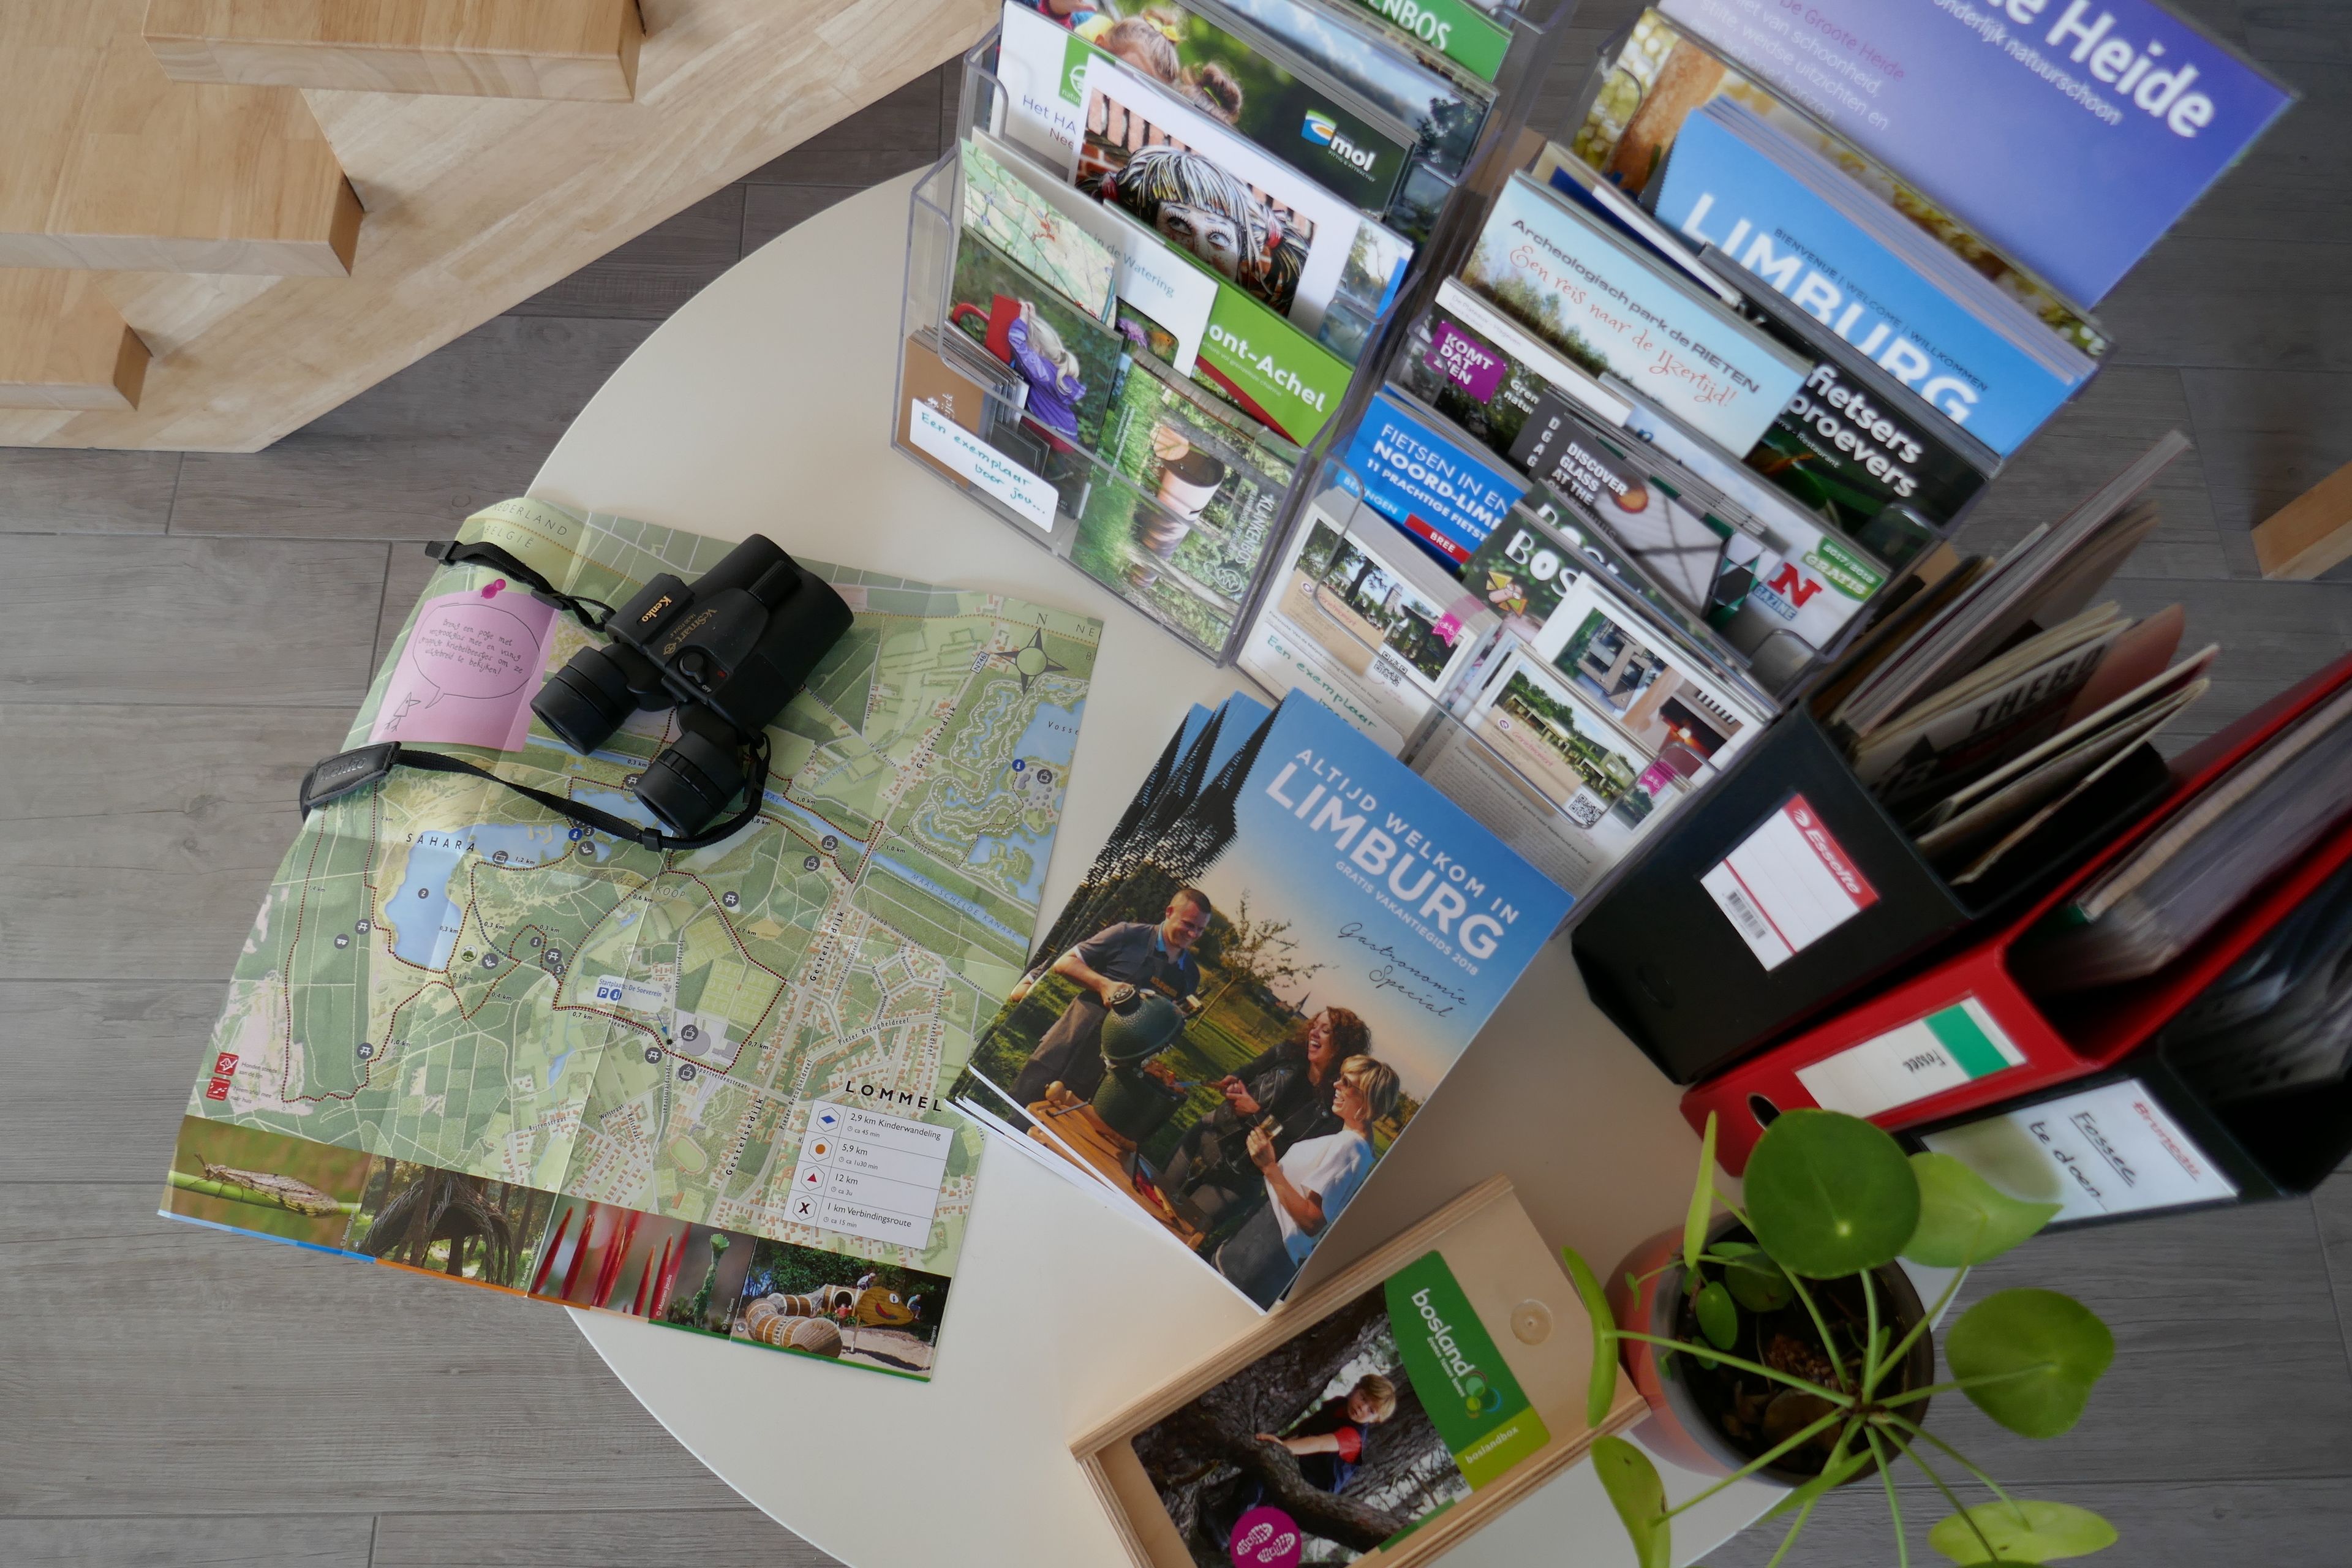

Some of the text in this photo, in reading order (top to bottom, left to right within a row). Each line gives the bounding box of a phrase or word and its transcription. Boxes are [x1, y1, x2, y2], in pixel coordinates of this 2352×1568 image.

[1763, 11, 1790, 36] van
[1791, 31, 1883, 97] schoonheid,
[1804, 9, 1905, 81] Groote Heide
[1743, 25, 1794, 66] weidse
[1795, 59, 1868, 116] uitzichten
[2004, 37, 2124, 126] natuurschoon
[2045, 0, 2215, 138] Heide
[1022, 94, 1051, 119] Het
[1331, 135, 1376, 172] mol
[1120, 253, 1175, 299] Watering
[1509, 245, 1548, 282] Een
[1554, 276, 1587, 305] reis
[1589, 303, 1632, 334] naar
[1632, 329, 1653, 353] de
[1511, 219, 1761, 394] Archeologisch park de RIETEN
[1681, 193, 1980, 424] LIMBURG
[1773, 227, 1989, 393] BIENVENUE WELCOME WILLKOMMEN
[1208, 322, 1325, 413] ont-Achel
[1439, 345, 1473, 374] DAT
[1444, 333, 1494, 371] KOMT
[1433, 358, 1472, 386] ZEN
[1510, 379, 1540, 405] Gren
[1806, 363, 1923, 465] fietsers
[921, 412, 1031, 485] Een exemplaar
[1381, 423, 1483, 497] FIETSEN IN
[1780, 393, 1918, 499] proevers
[975, 464, 1005, 484] voor
[1551, 468, 1595, 505] AT THE
[1559, 454, 1600, 492] GLASS
[1566, 441, 1630, 497] DISCOVER
[1366, 458, 1380, 473] 11
[1382, 469, 1449, 518] PRACHTIGE
[483, 524, 535, 549] BELGIË
[492, 502, 568, 537] NEDERLAND
[1235, 494, 1274, 567] KLANKENBOS
[1429, 532, 1457, 554] BREE
[1805, 554, 1867, 595] GRATIS
[1822, 543, 1877, 584] 2017/2018
[641, 595, 673, 622] Kenko
[469, 638, 482, 647] mee
[486, 643, 495, 652] en
[500, 648, 521, 663] vang
[478, 628, 494, 641] potje
[499, 635, 513, 647] met
[457, 655, 464, 663] te
[497, 658, 524, 674] om ze
[973, 654, 988, 673] N746
[701, 684, 712, 693] OFF
[1266, 635, 1292, 662] Een
[1295, 660, 1378, 729] exemplaar
[916, 706, 957, 769] Gestelsedijk
[318, 756, 368, 782] Kenko
[405, 832, 476, 853] SAHARA
[886, 844, 895, 853] 1,0
[1295, 749, 1377, 812] ALTIJD
[1385, 812, 1486, 898] WELKOM
[1490, 897, 1520, 925] IN
[1264, 761, 1504, 960] LIMBURG
[1804, 829, 1861, 894] Esselte
[589, 870, 687, 899] NIEUWE KOOP
[911, 873, 1017, 939] MAAS-SCHELDE KANAAL
[1336, 861, 1479, 976] GRATIS VAKANTIEGIDS 2018
[809, 911, 845, 982] Gestelsedijk
[868, 911, 926, 949] Jacob Smitsdreef
[1338, 922, 1467, 1006] Gastronomie
[598, 978, 628, 990] Startplaats:
[636, 986, 663, 998] Soeverein
[834, 975, 847, 992] David
[936, 986, 945, 1009] Albert
[1369, 965, 1453, 1018] Special
[630, 1025, 649, 1038] Kopen
[758, 1042, 770, 1050] km
[837, 1017, 911, 1046] Pieter Breugheldreef
[696, 1064, 748, 1090] Sportveldenstraat
[598, 1104, 625, 1120] Welstraat
[845, 1080, 943, 1113] LOMMEL
[528, 1116, 567, 1131] Rijtenstraat
[627, 1112, 641, 1140] Rolstraat
[725, 1097, 764, 1175] Gestelsedijk
[778, 1108, 792, 1131] Pieter
[850, 1112, 942, 1141] 2,9 km Kinderwandeling
[2029, 1121, 2051, 1145] te
[841, 1143, 868, 1156] 5,9 km
[2132, 1101, 2201, 1177] Bruneau
[834, 1173, 859, 1186] 12 km
[853, 1158, 878, 1170] 1u30 min
[833, 1204, 912, 1228] km Verbindingsroute
[838, 1218, 858, 1229] 15 min
[657, 1289, 668, 1310] Maarten
[726, 1297, 735, 1313] Geuns
[1411, 1287, 1476, 1378] bosland
[1464, 1425, 1520, 1464] boslandbox
